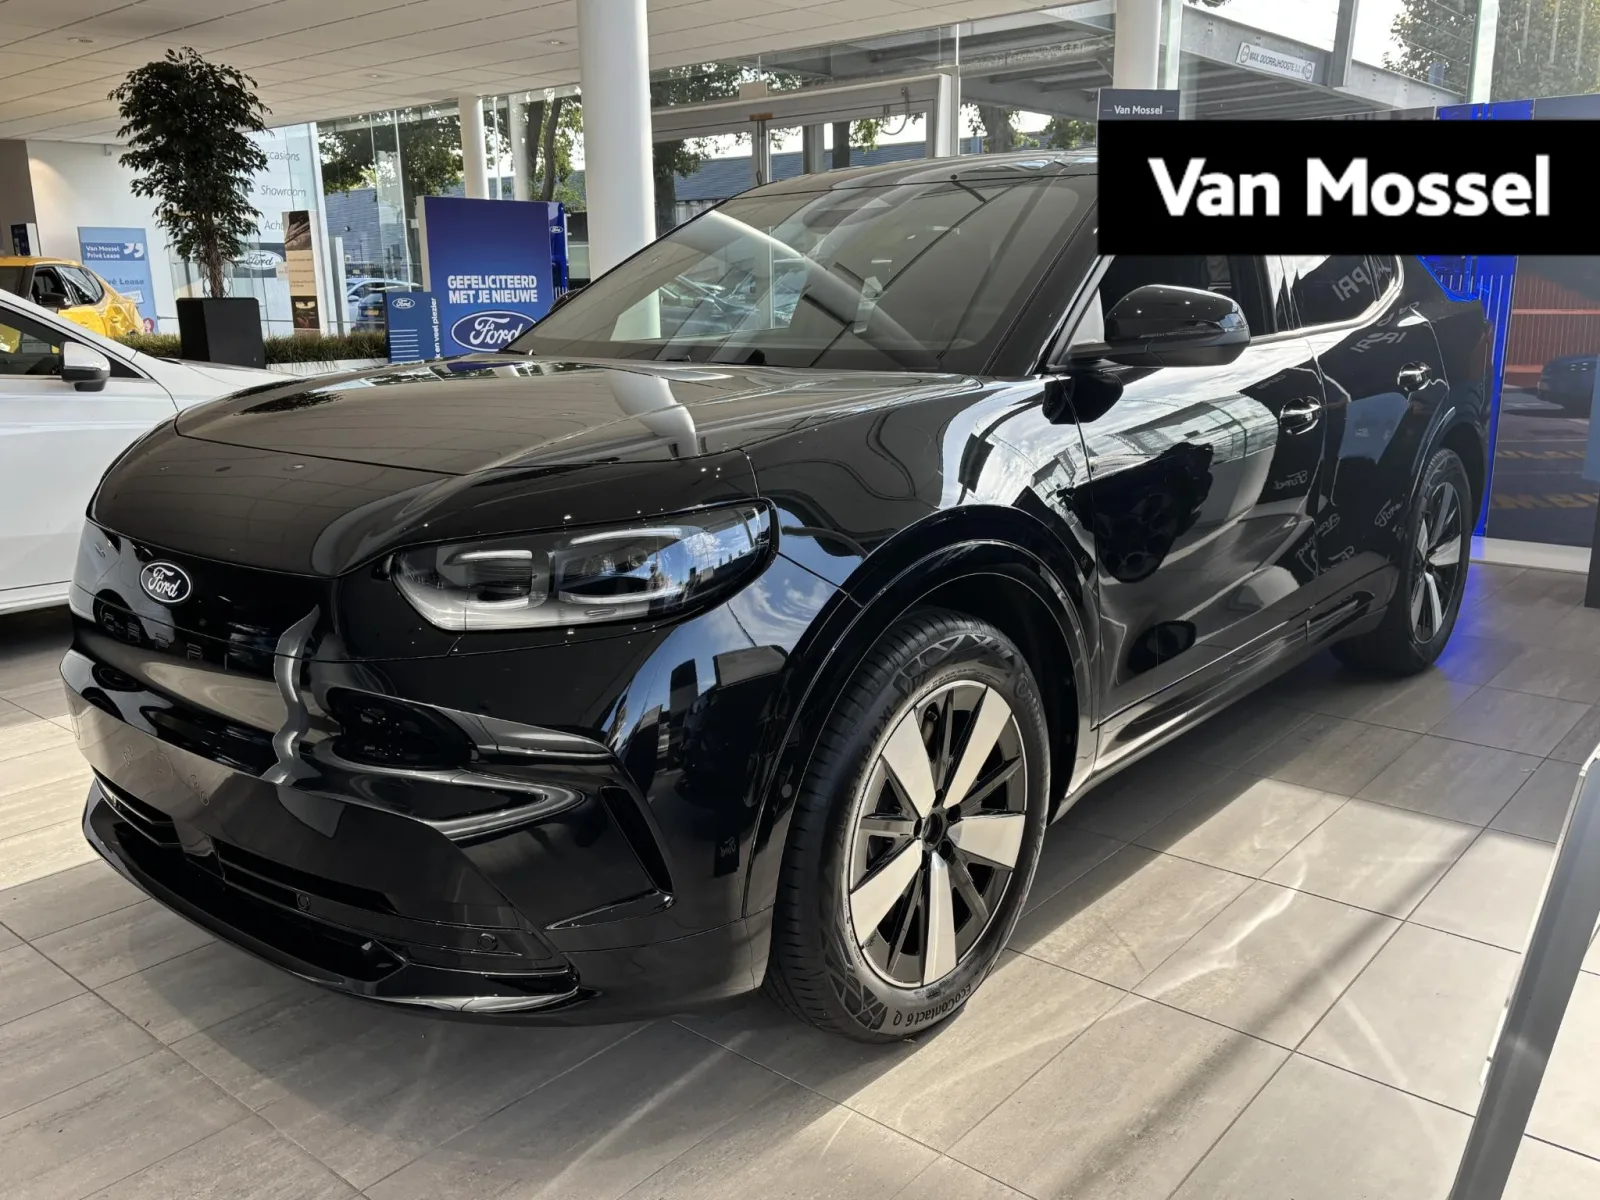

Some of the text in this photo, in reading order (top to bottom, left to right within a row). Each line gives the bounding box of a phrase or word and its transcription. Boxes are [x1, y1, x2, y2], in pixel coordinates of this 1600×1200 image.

[1114, 105, 1163, 115] Van Mossel
[262, 150, 300, 162] ccasions
[261, 184, 307, 197] Showroom
[447, 275, 538, 290] GEFELICITEERD
[395, 298, 412, 308] Ford
[449, 290, 538, 304] MET JE NIEUWE
[430, 297, 439, 324] plezier
[432, 325, 440, 342] veel
[469, 316, 523, 345] Ford
[434, 342, 440, 353] en
[148, 566, 181, 598] Ford
[913, 984, 972, 1026] EcoContact
[892, 1009, 903, 1027] Q
[904, 1013, 914, 1027] 6
